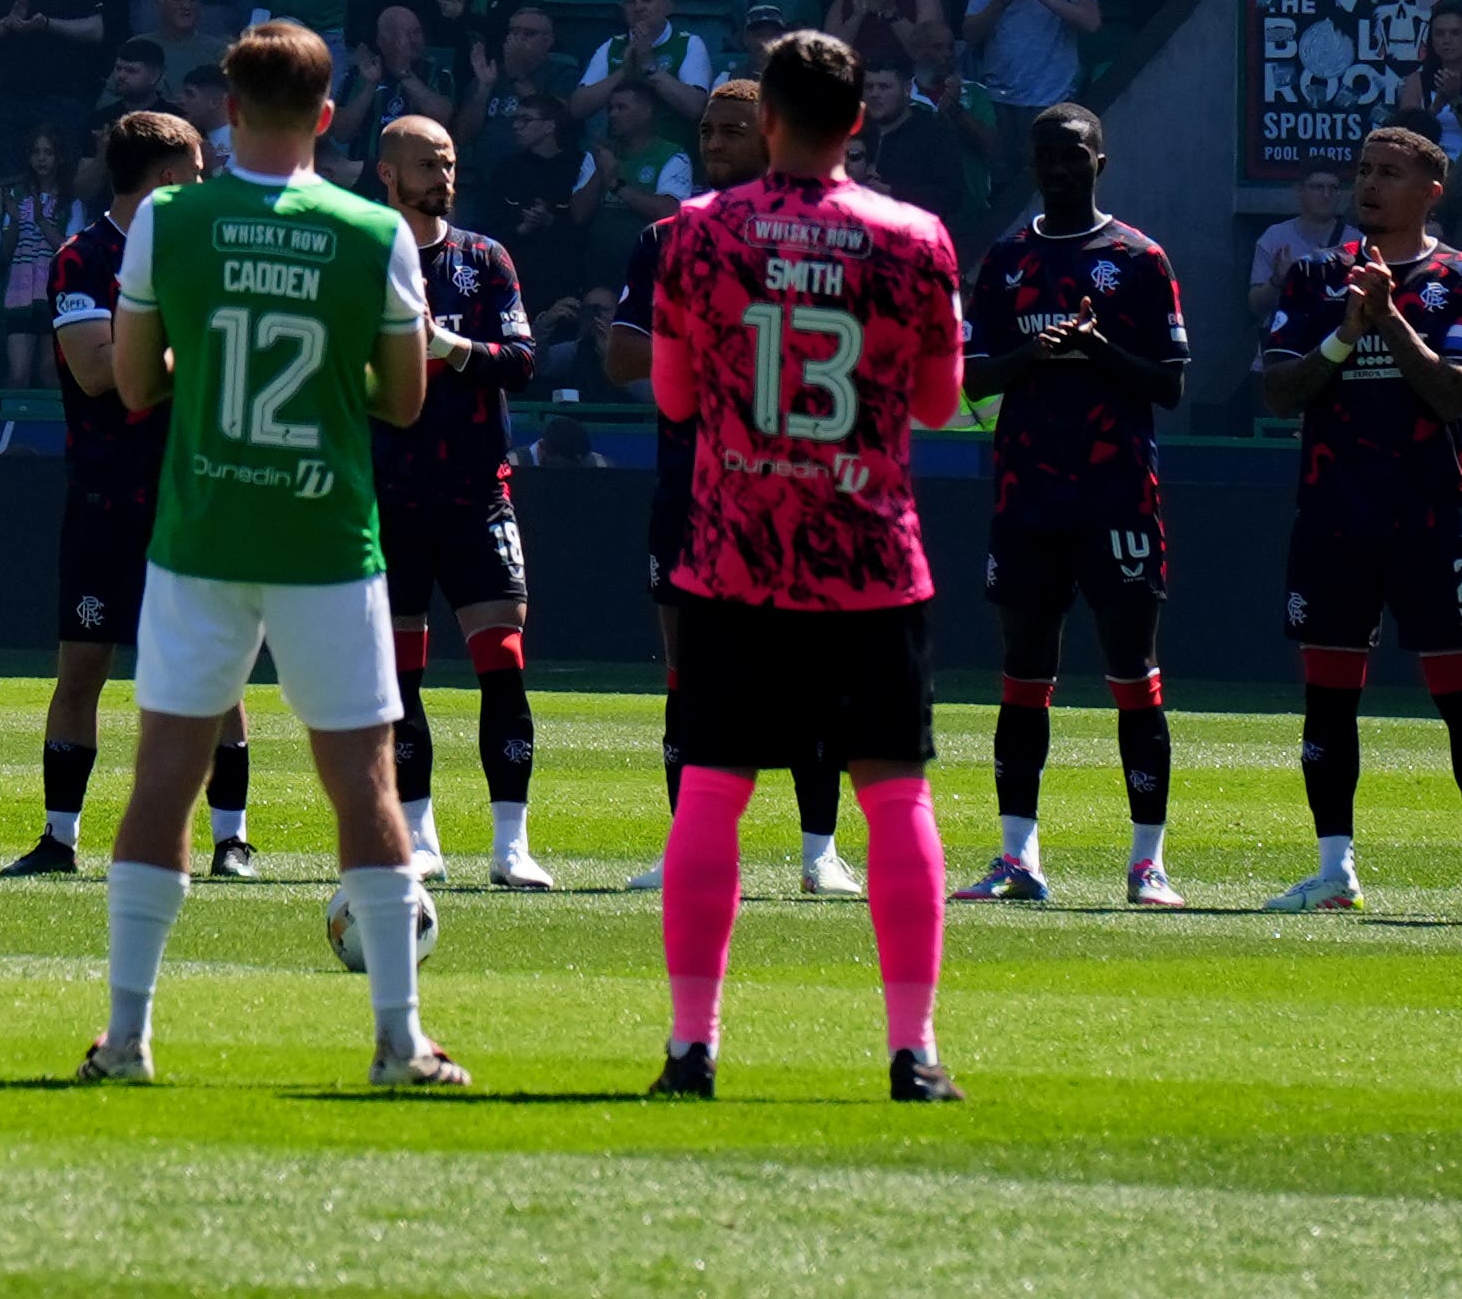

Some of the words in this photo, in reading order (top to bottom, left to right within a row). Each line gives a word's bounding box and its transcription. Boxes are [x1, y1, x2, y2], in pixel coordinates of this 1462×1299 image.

[1264, 112, 1363, 141] SPORTS
[1265, 146, 1300, 161] POOL
[222, 222, 287, 247] WHISKY
[290, 228, 329, 254] ROW
[754, 218, 821, 244] WHISKY
[826, 225, 865, 249] ROW
[222, 259, 320, 301] CADDEN
[766, 256, 844, 297] SMITH
[208, 306, 328, 451] 12
[741, 302, 865, 443] 13
[192, 453, 291, 488] Dunedin
[723, 448, 829, 478] Dunedin
